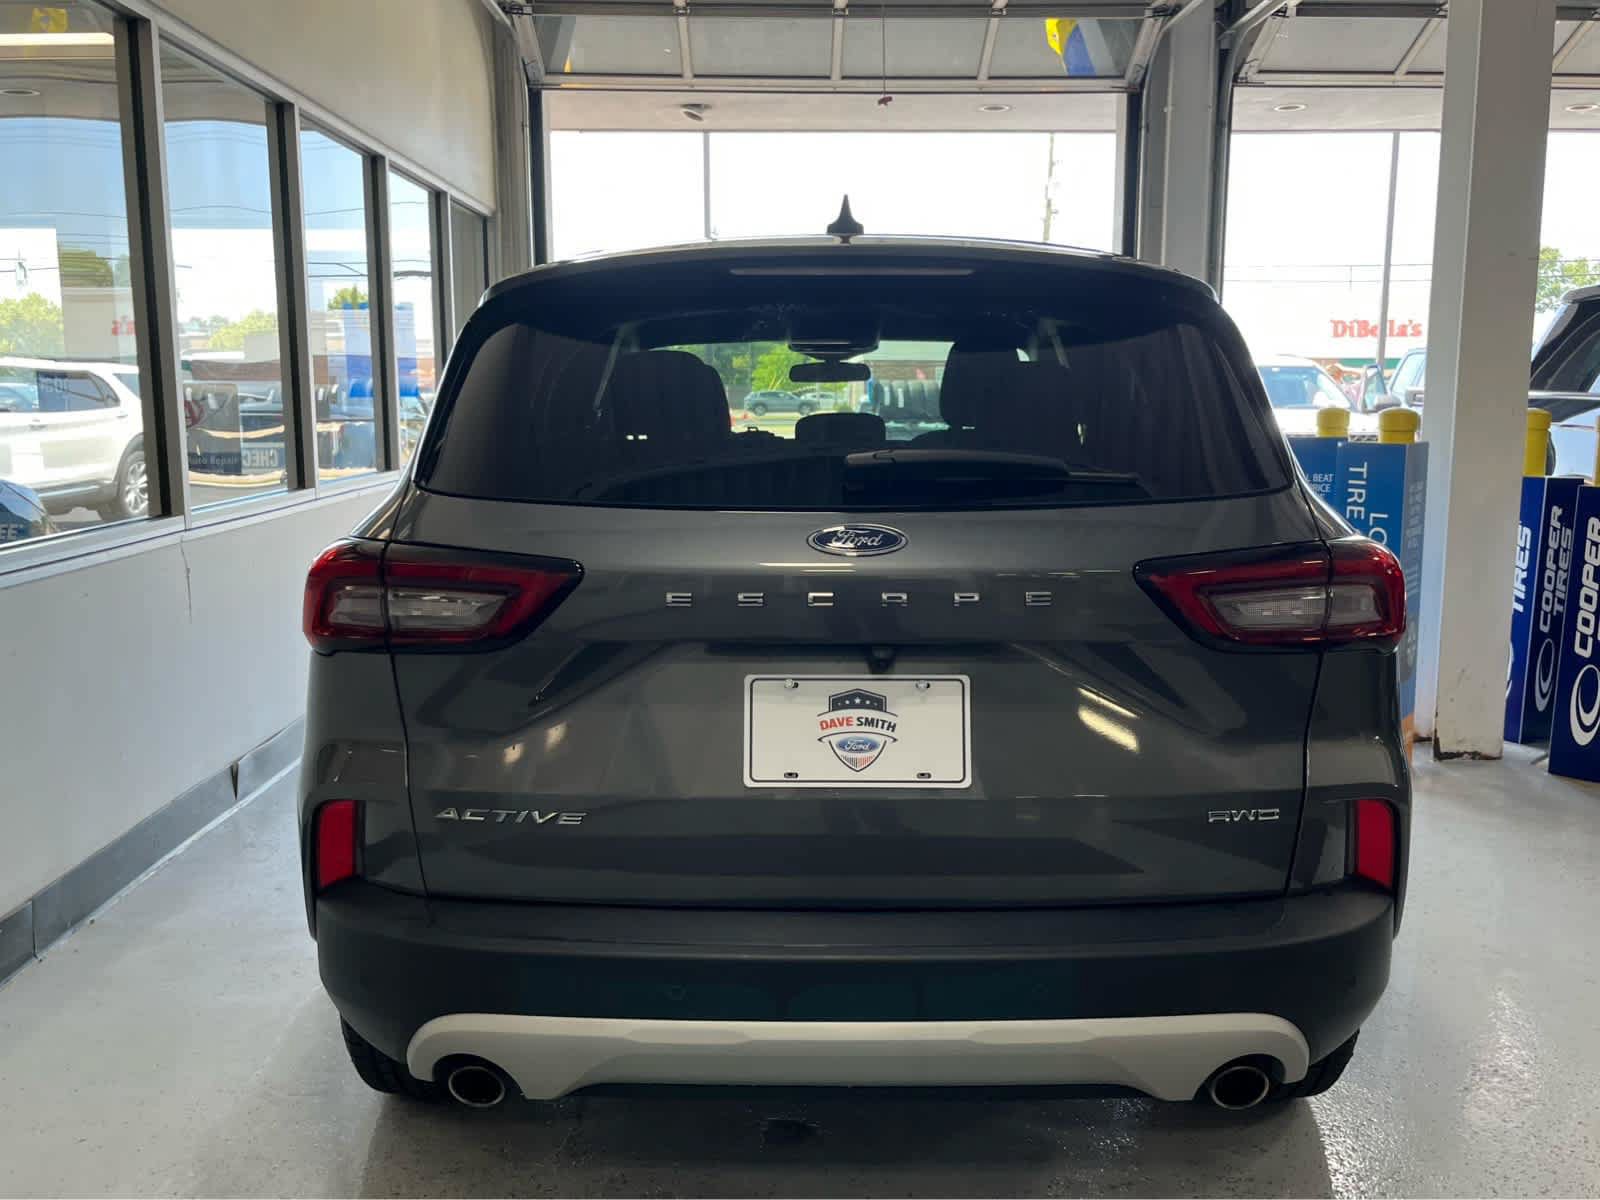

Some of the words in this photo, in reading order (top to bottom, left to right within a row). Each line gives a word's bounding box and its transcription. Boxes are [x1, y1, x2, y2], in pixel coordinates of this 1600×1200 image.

[1330, 319, 1423, 338] DiBela's
[1312, 483, 1331, 493] RICE
[1345, 461, 1368, 520] TIRE
[829, 529, 884, 548] Ford
[1512, 524, 1532, 613] TIRES
[1539, 505, 1563, 633] COOPER
[1553, 526, 1572, 616] TIRES
[1574, 516, 1600, 659] COOPER
[665, 591, 1052, 607] ESCAPE
[820, 716, 854, 731] DAVE
[856, 716, 897, 733] SMITH
[844, 739, 871, 750] Ford
[434, 807, 588, 825] ACTIVE
[1207, 808, 1280, 823] AWD
